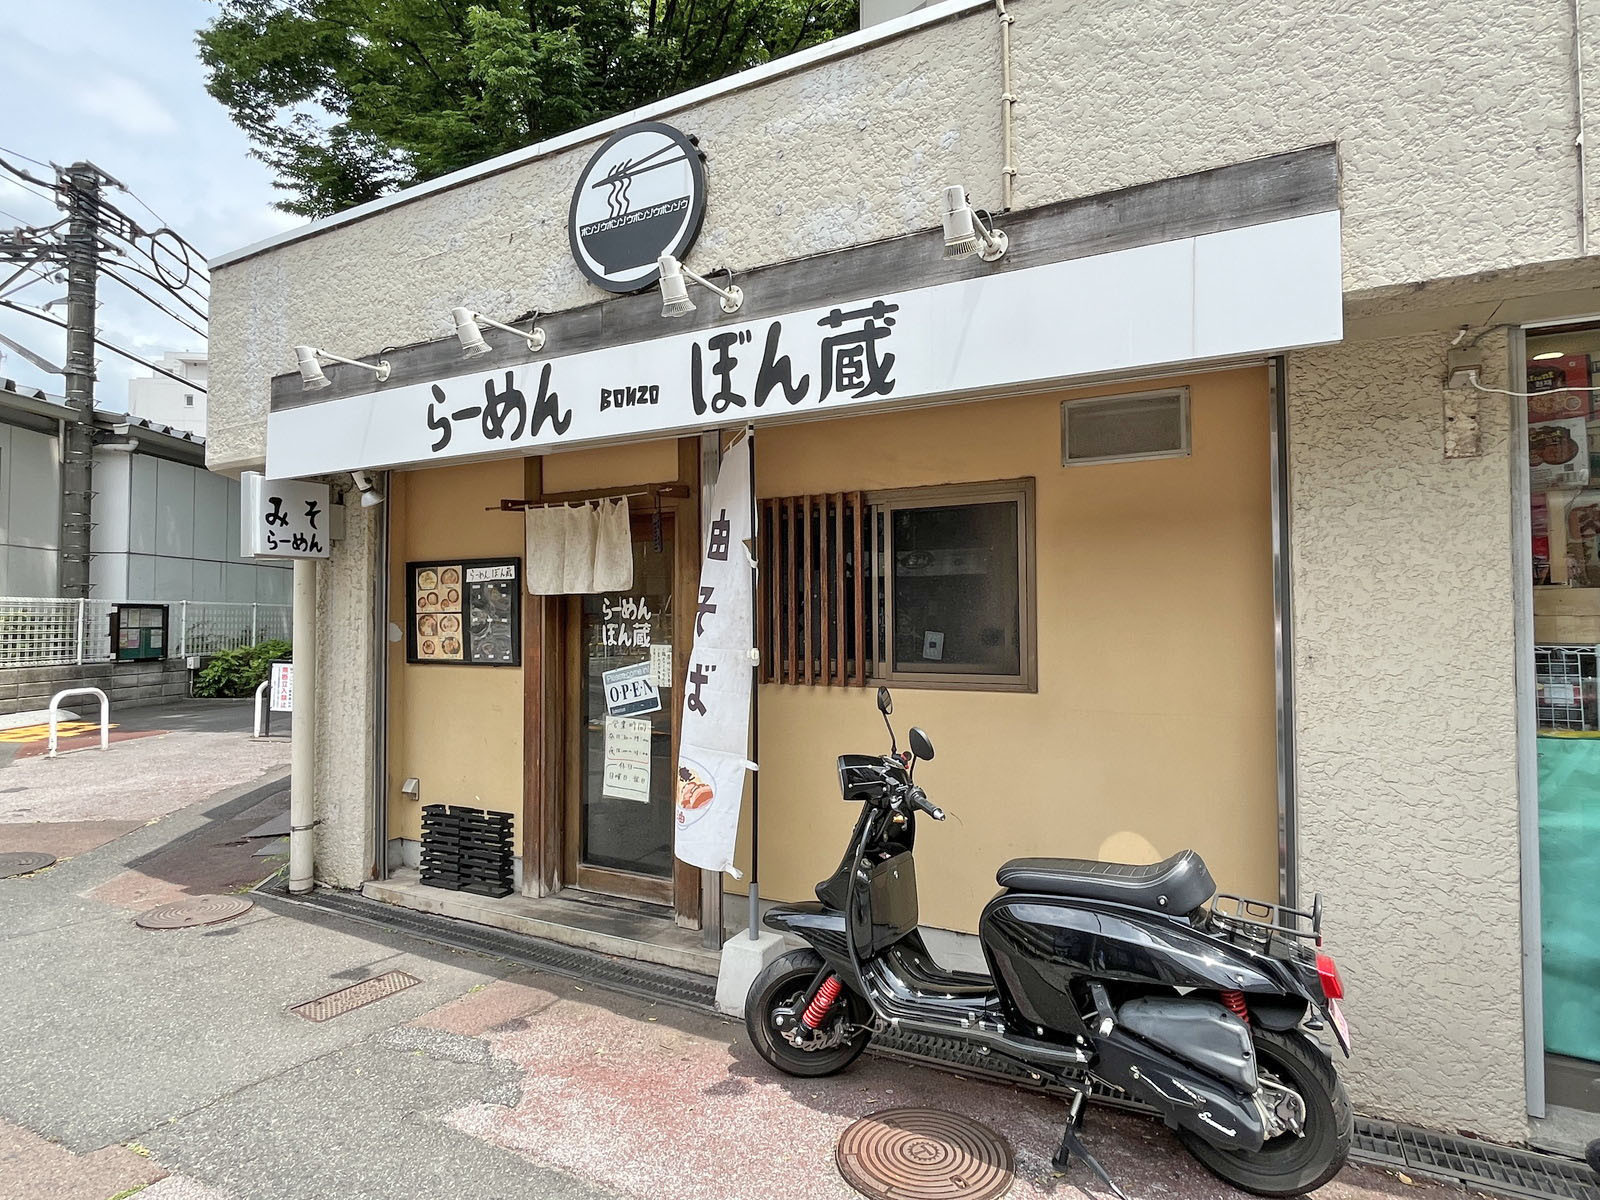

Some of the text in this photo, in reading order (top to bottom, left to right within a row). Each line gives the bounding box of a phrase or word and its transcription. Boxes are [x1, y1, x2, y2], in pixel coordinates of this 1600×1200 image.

[426, 299, 900, 453] らーめん BONZO ぼん蔵
[265, 496, 322, 530] みそ
[267, 529, 323, 553] らーめん
[602, 596, 652, 621] らーめん
